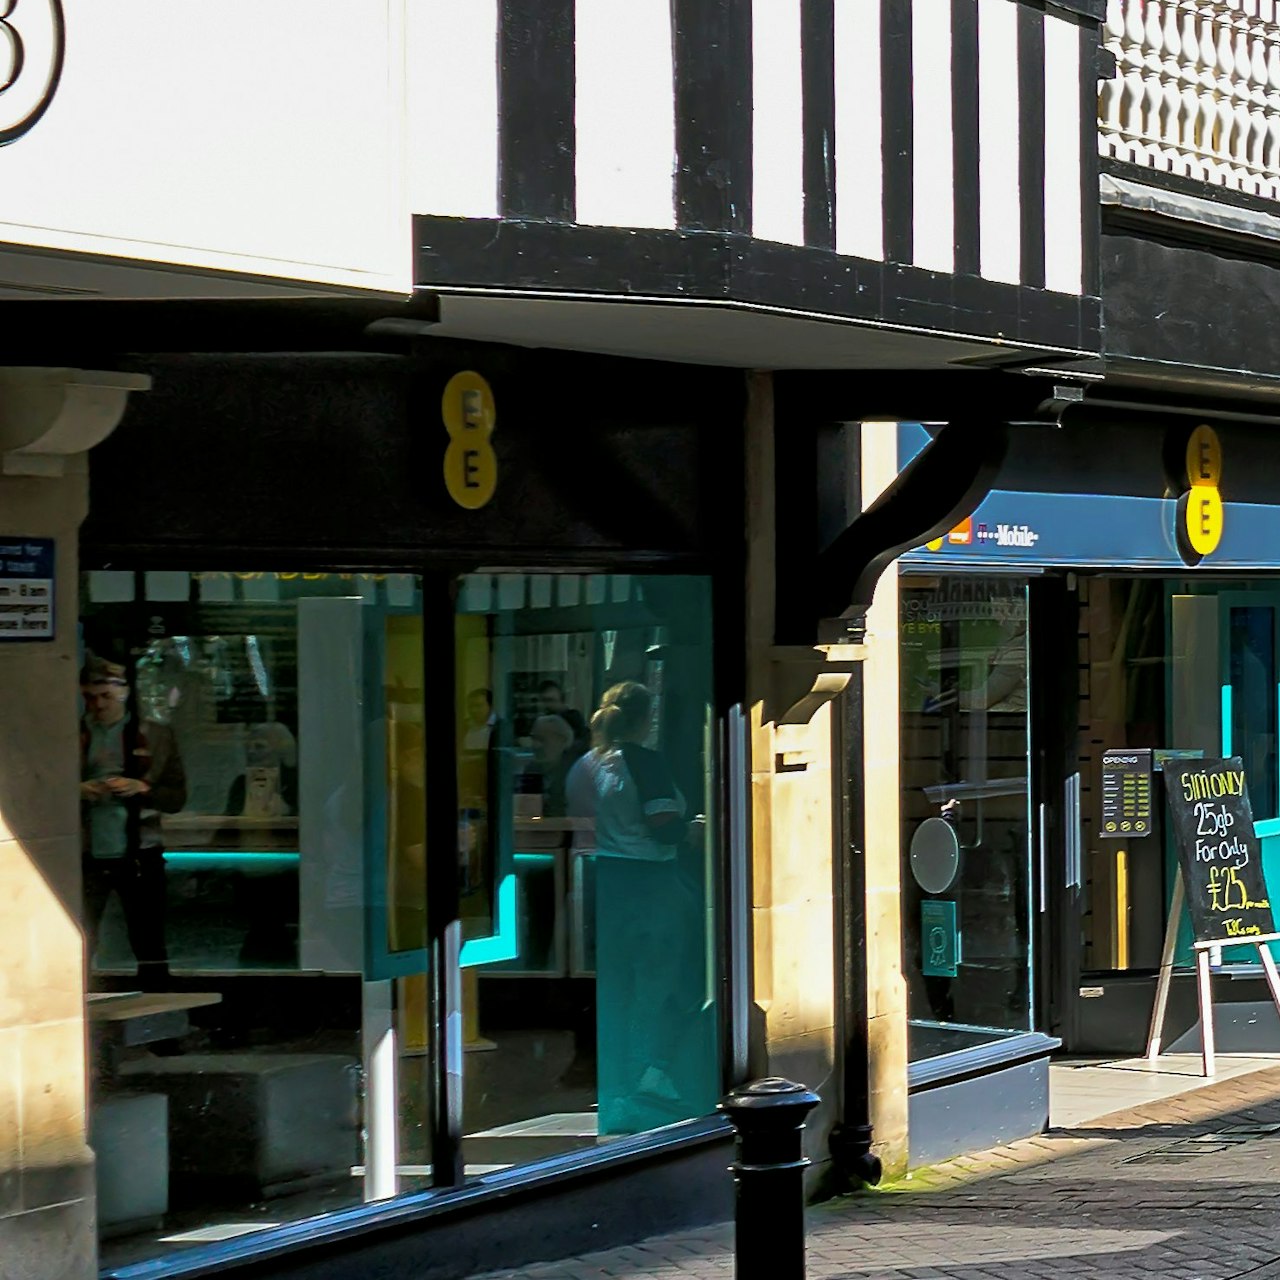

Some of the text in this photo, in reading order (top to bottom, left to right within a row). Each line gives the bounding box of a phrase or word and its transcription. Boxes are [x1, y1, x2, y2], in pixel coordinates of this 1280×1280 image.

[1194, 803, 1235, 837] 25gb
[1195, 839, 1219, 863] For
[1206, 866, 1248, 911] £25
